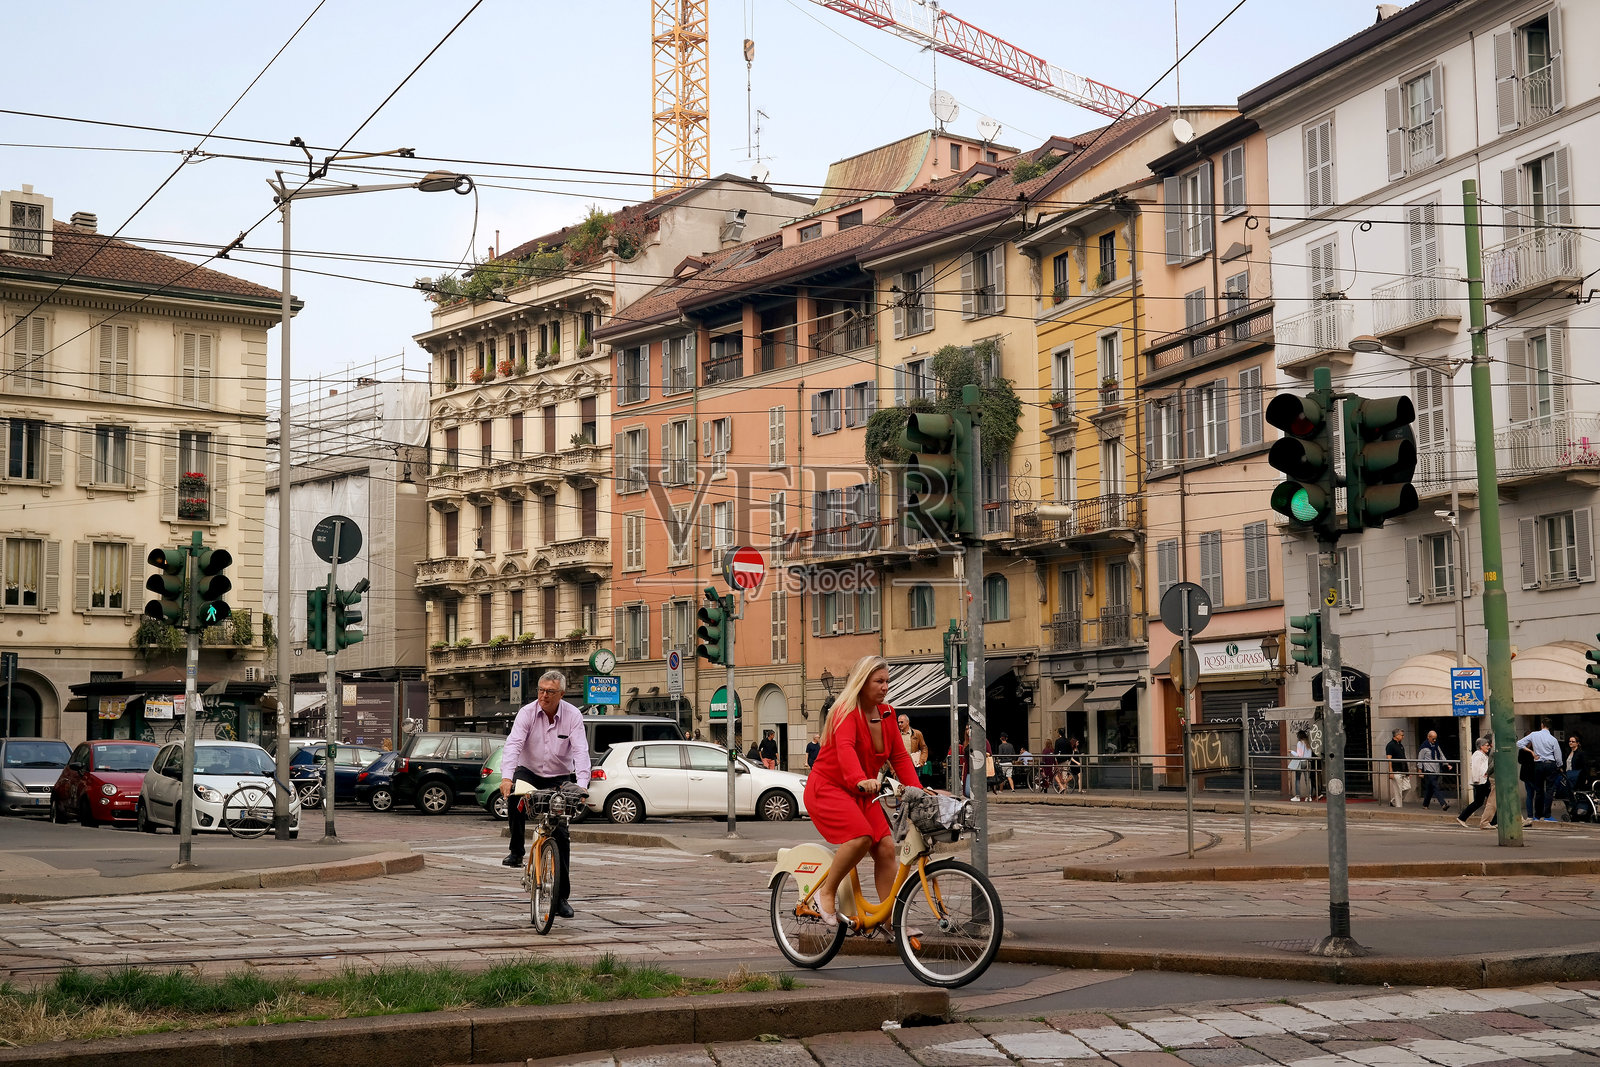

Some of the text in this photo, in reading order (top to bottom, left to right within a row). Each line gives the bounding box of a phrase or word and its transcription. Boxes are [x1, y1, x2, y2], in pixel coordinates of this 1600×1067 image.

[1204, 655, 1227, 669] ROSSI
[513, 672, 519, 686] P
[1454, 680, 1481, 690] FINE
